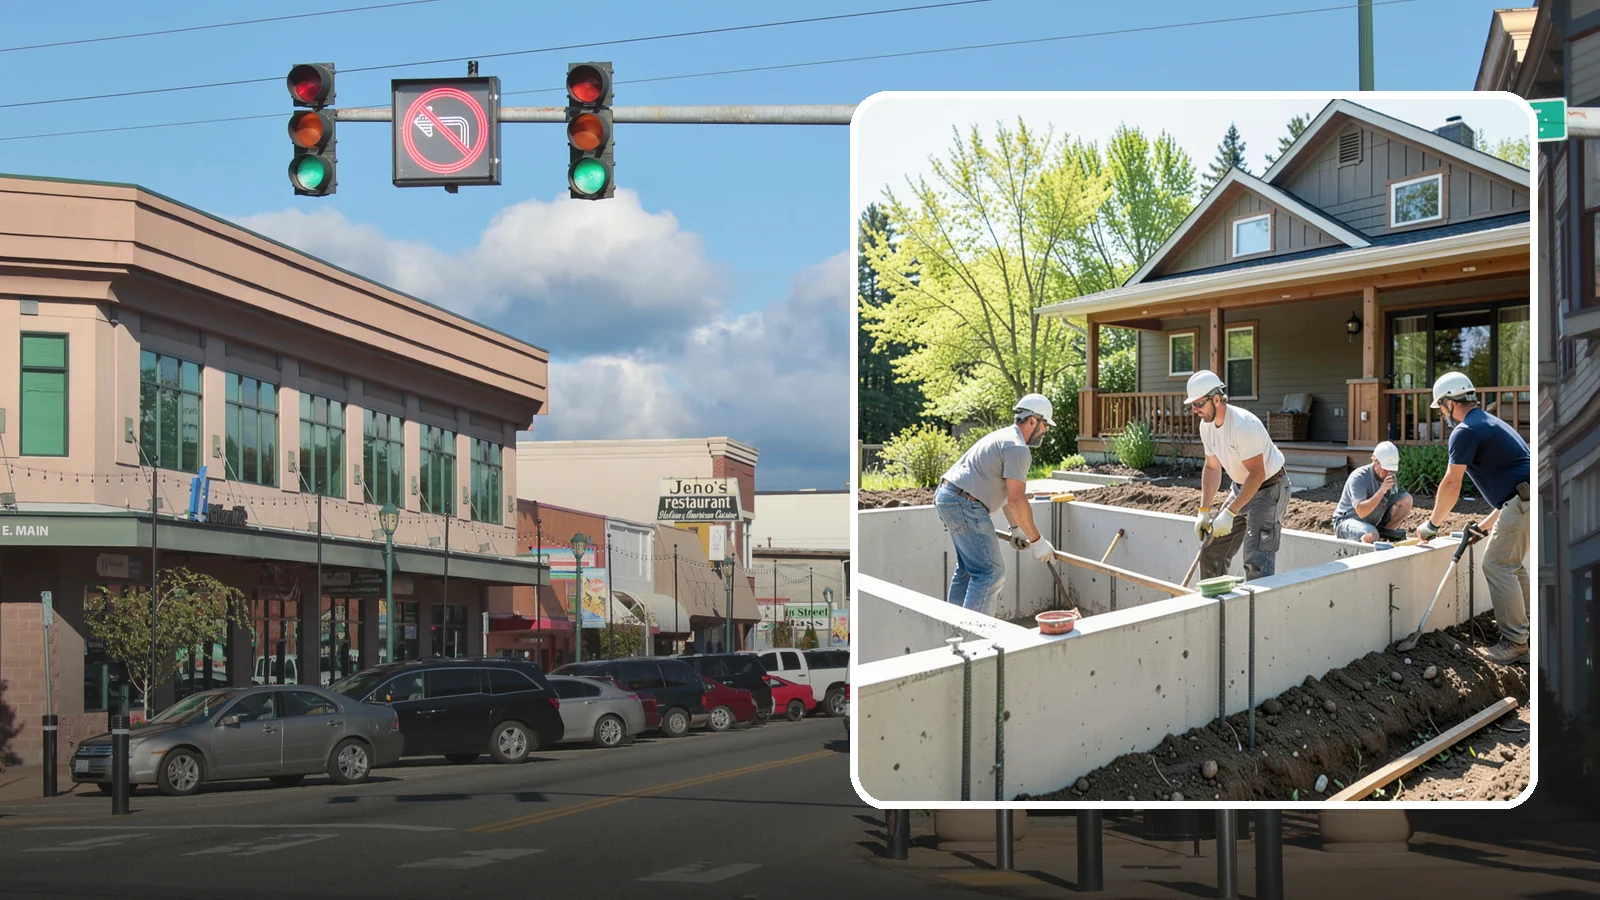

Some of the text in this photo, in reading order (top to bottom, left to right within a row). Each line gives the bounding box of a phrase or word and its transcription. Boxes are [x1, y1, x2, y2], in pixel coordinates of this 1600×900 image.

[669, 480, 727, 494] Jeno's
[665, 496, 731, 509] restaurant
[658, 509, 682, 519] Italian
[686, 509, 715, 519] American
[715, 509, 738, 519] Cuisine
[2, 525, 49, 536] E. MAIN
[797, 607, 829, 617] Street
